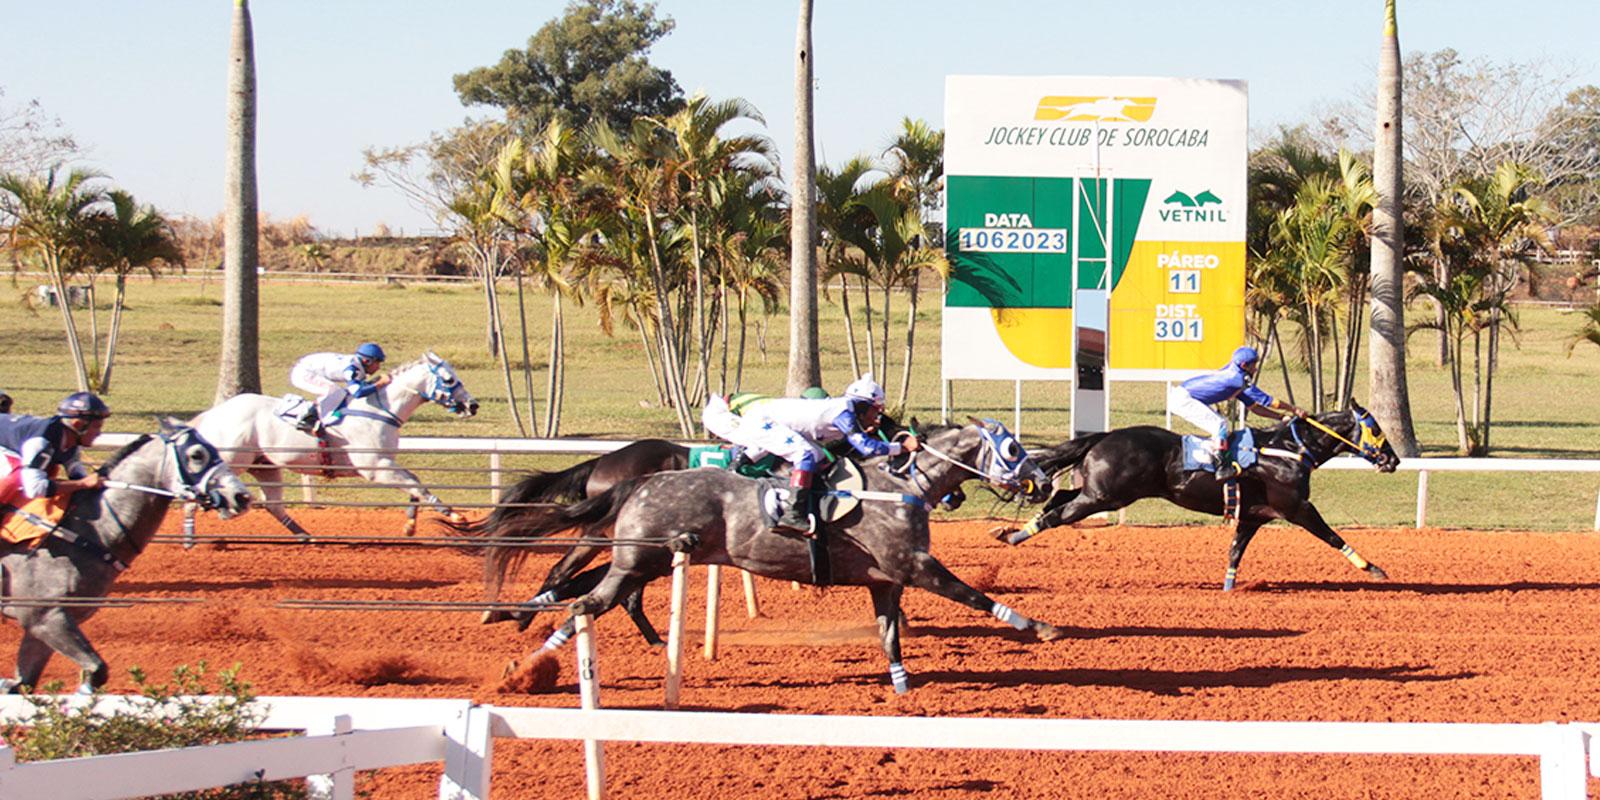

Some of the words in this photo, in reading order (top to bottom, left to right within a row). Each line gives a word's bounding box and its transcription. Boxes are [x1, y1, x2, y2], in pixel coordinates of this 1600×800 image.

[985, 127, 1047, 145] JOCKEY
[1048, 128, 1091, 146] CLUB
[1097, 128, 1118, 146] DE
[1123, 128, 1209, 147] SOROCABA
[984, 213, 1033, 228] DATA
[1159, 209, 1226, 223] VETNIL
[962, 231, 1064, 250] 1062023
[1157, 252, 1219, 269] PÁREO
[1170, 273, 1196, 290] 11
[1156, 304, 1199, 318] DIST.
[1156, 320, 1199, 338] 301
